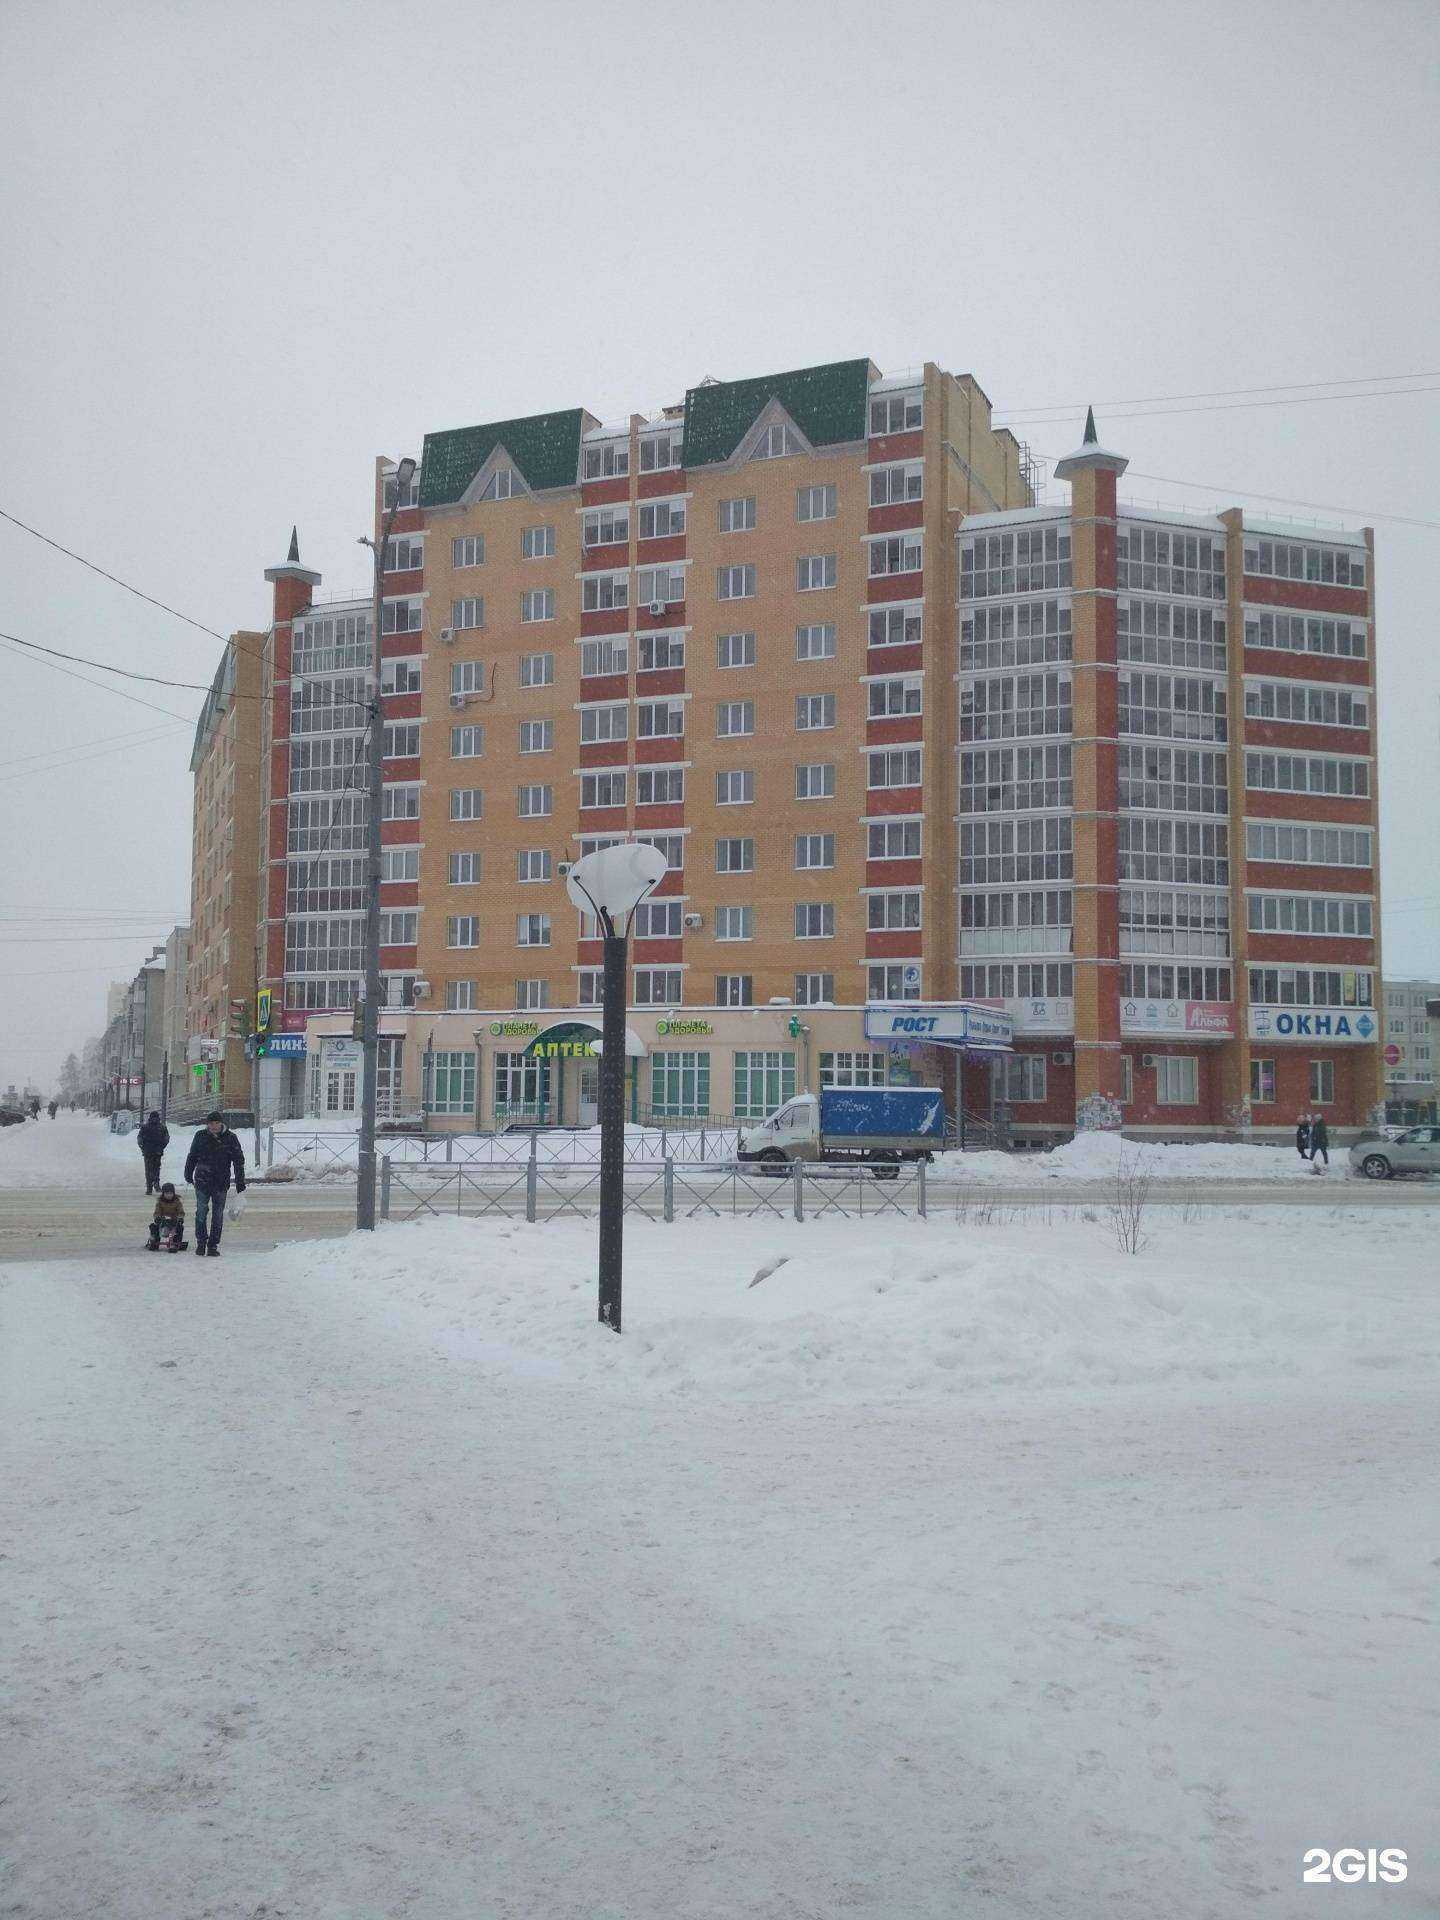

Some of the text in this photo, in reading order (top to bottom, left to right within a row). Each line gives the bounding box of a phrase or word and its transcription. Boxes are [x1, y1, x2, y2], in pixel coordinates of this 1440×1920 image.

[891, 1017, 939, 1032] РОСТ
[1276, 1013, 1351, 1036] ОКНА
[533, 1043, 596, 1057] АПТЕК
